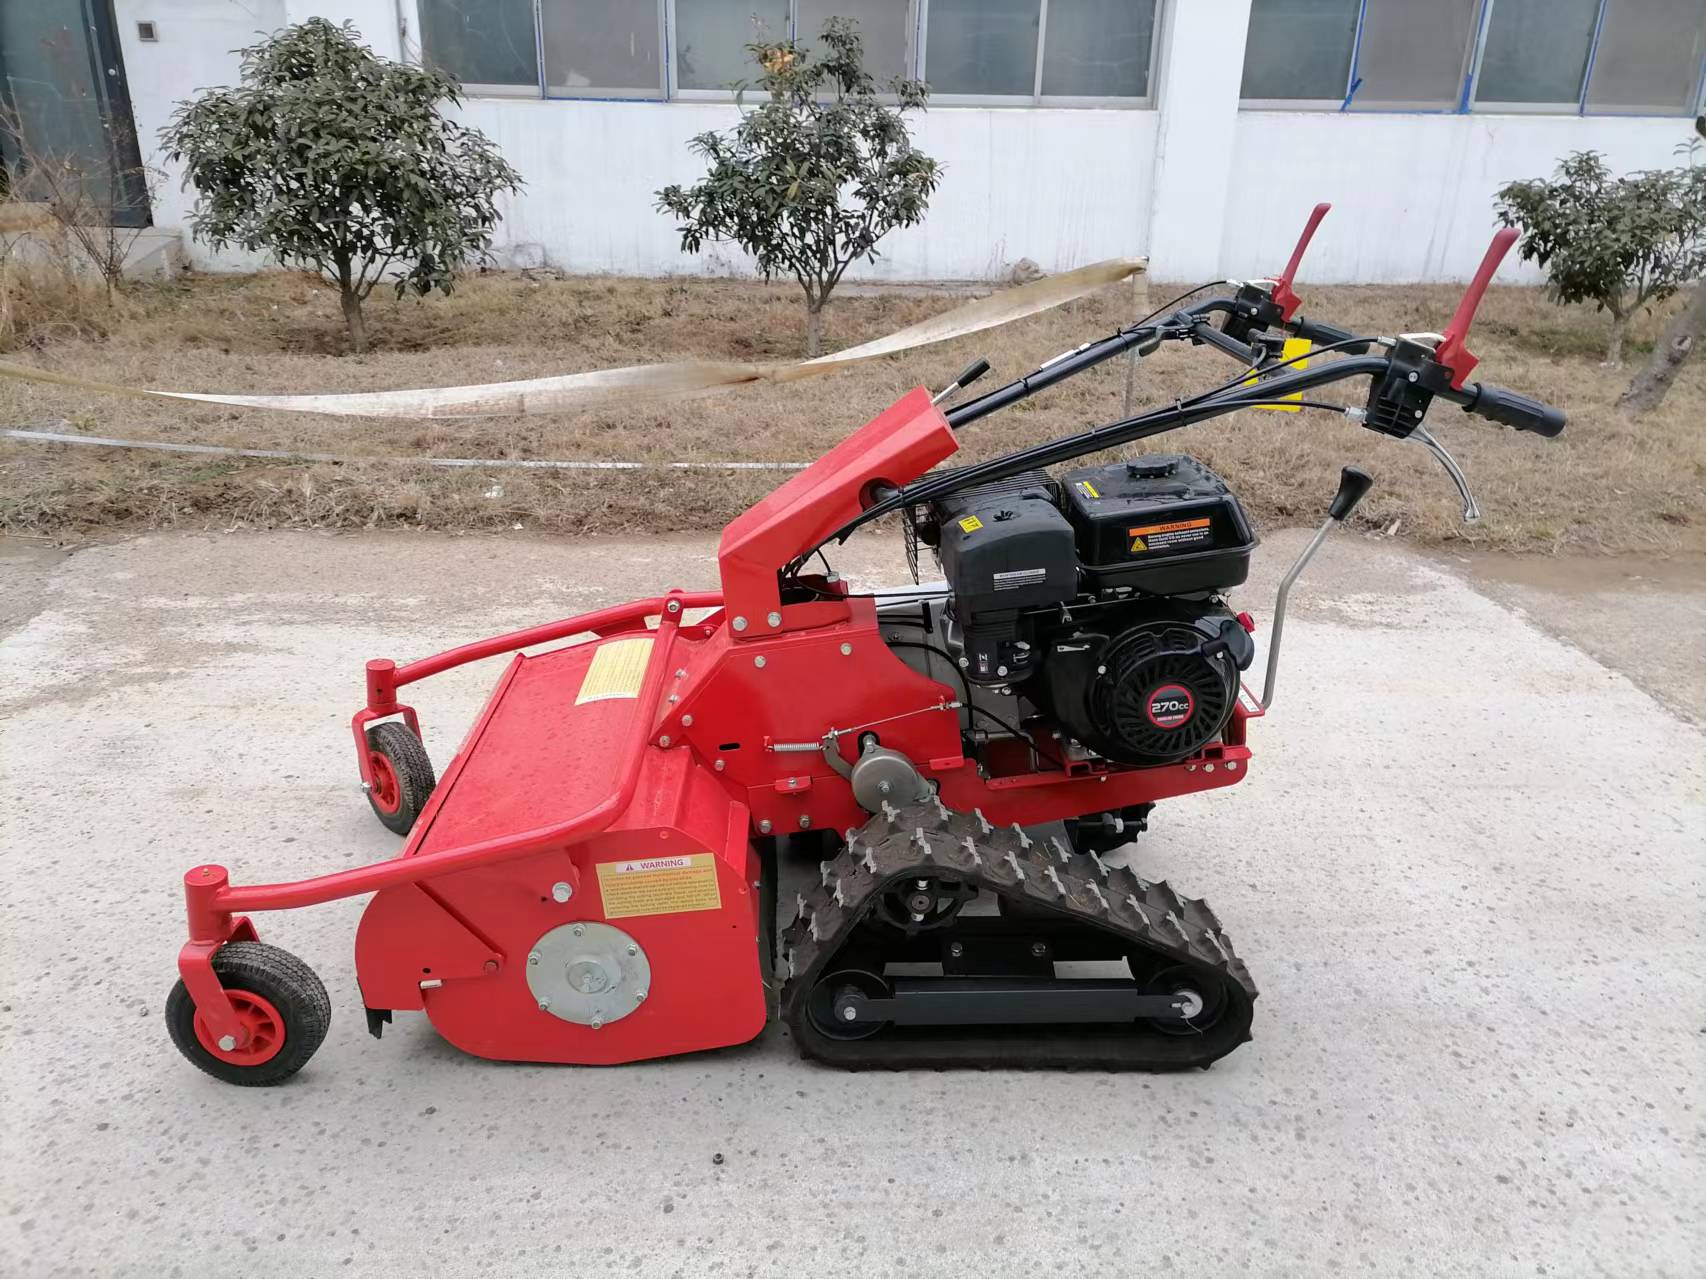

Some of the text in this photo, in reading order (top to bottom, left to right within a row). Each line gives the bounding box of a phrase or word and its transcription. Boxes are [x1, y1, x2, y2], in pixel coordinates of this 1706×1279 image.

[1160, 522, 1191, 530] WARNING
[1152, 701, 1189, 713] 270cc
[640, 859, 684, 870] WARNING
